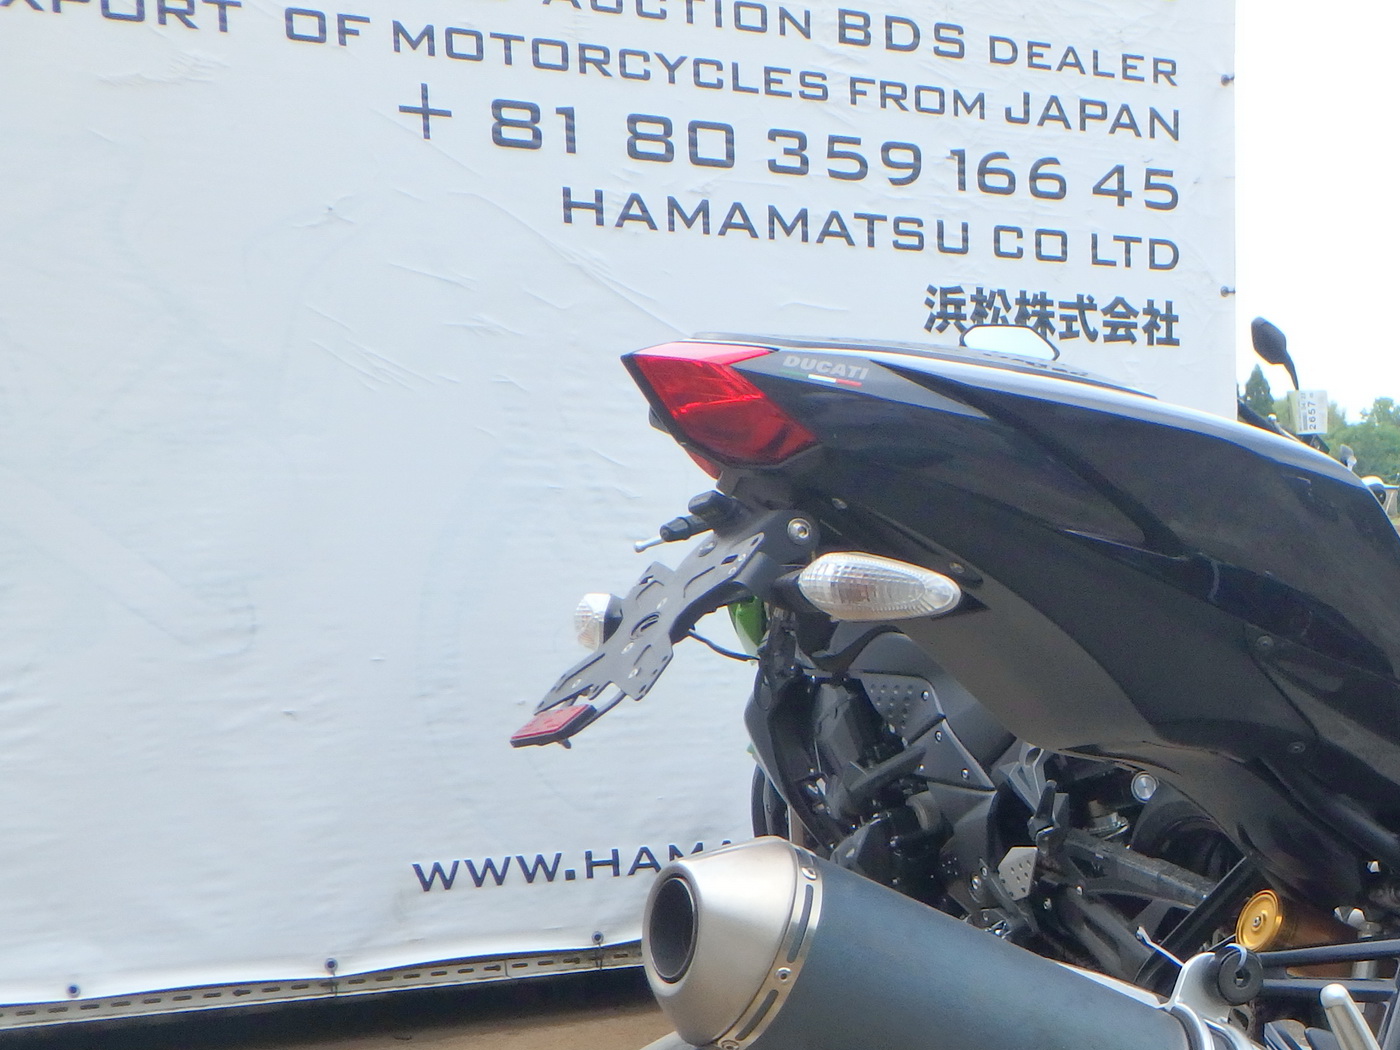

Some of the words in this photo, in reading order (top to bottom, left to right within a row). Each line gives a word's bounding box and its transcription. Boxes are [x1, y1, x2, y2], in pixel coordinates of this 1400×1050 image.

[284, 6, 372, 47] OF
[392, 19, 829, 102] MOTORCYCLES
[849, 76, 986, 120] FROM
[1004, 91, 1180, 142] JAPAN
[542, 0, 812, 40] CTION
[837, 7, 966, 59] BDS
[988, 34, 1179, 87] DEALER
[490, 98, 577, 155] 81
[626, 112, 736, 169] 80
[767, 127, 922, 186] 359
[949, 148, 1067, 201] 166
[1092, 163, 1180, 211] 45
[562, 186, 970, 255] HAMAMATSU
[993, 224, 1068, 263] CO
[1090, 232, 1180, 271] LTD
[924, 283, 1181, 347] 浜松株式会社
[782, 355, 870, 380] DUCATI
